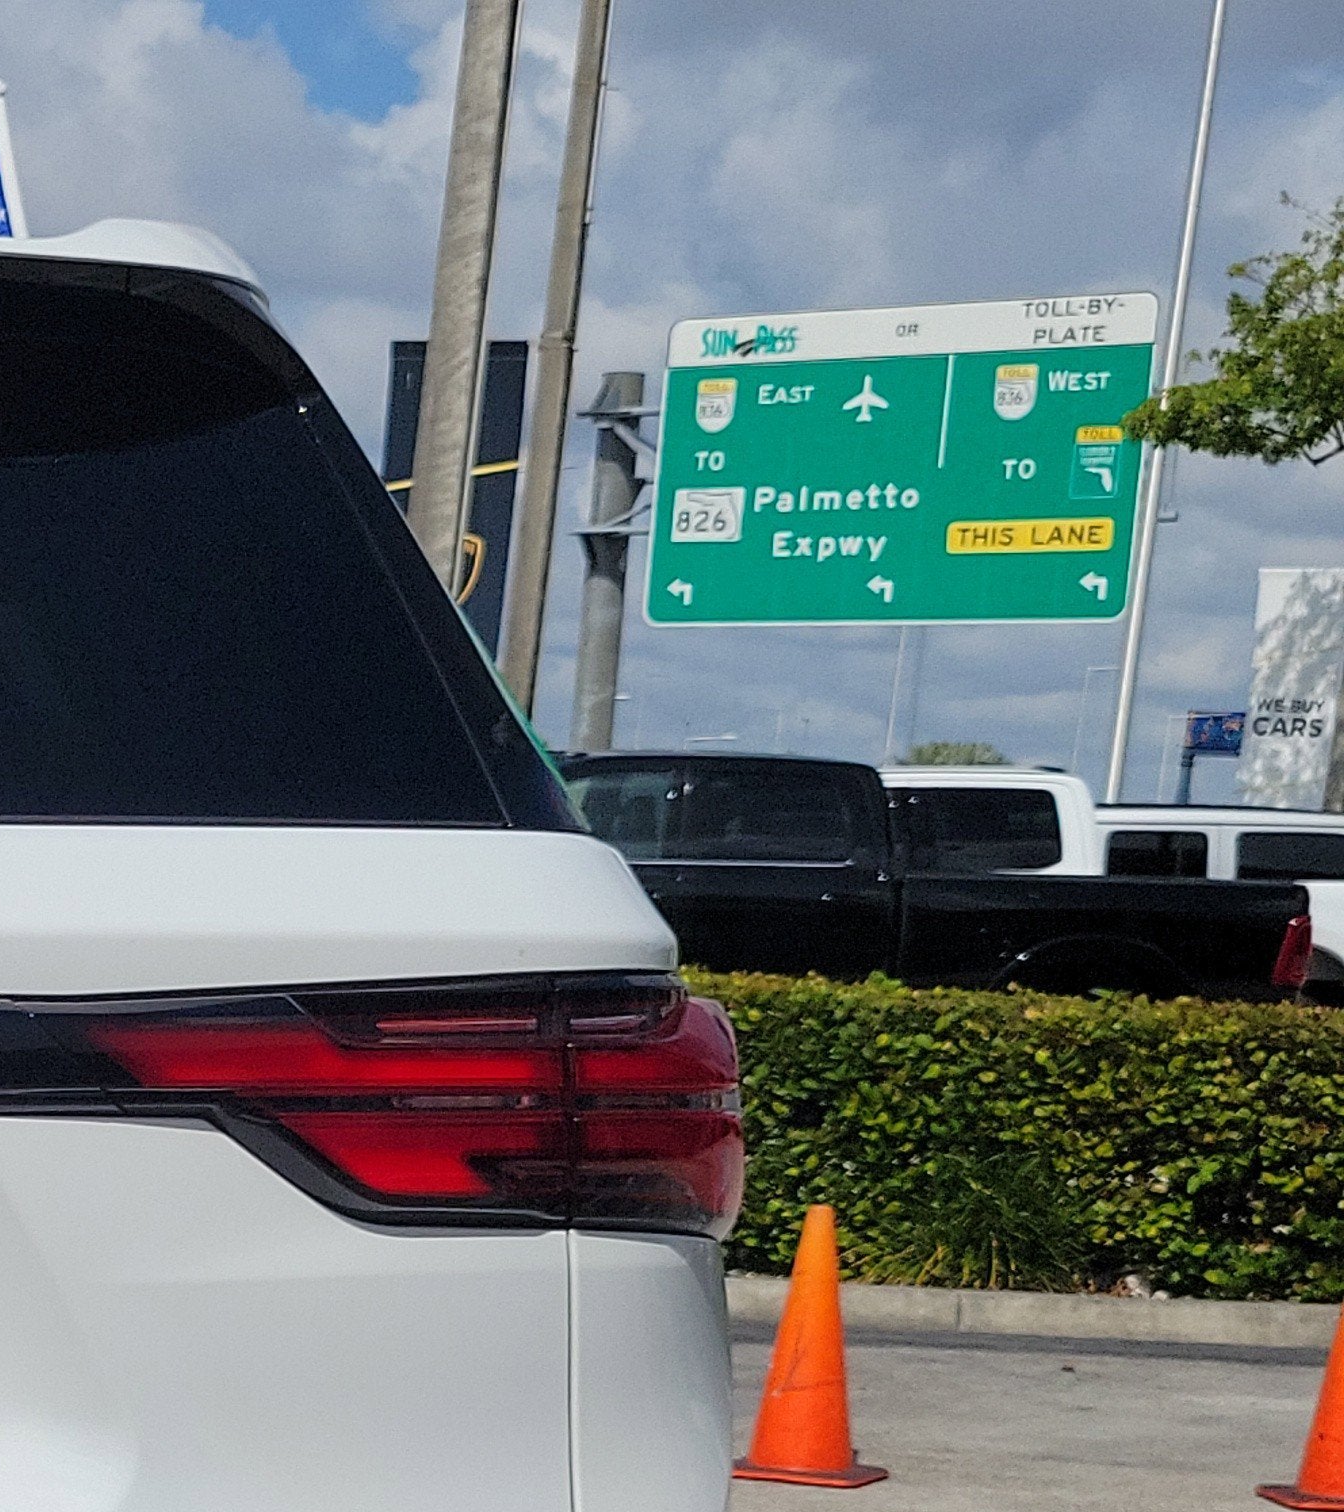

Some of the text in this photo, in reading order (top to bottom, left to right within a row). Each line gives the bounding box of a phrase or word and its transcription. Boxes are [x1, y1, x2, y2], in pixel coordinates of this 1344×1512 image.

[1032, 325, 1107, 344] PLATE
[1048, 369, 1112, 392] WEST
[757, 383, 815, 405] EAST
[694, 450, 726, 472] TO
[1002, 457, 1037, 480] TO
[753, 483, 920, 513] Palmetto
[675, 510, 727, 533] 826
[772, 530, 887, 562] Expwy
[957, 525, 1105, 547] THIS LANE
[1257, 698, 1286, 713] WE
[1252, 717, 1324, 738] CARS
